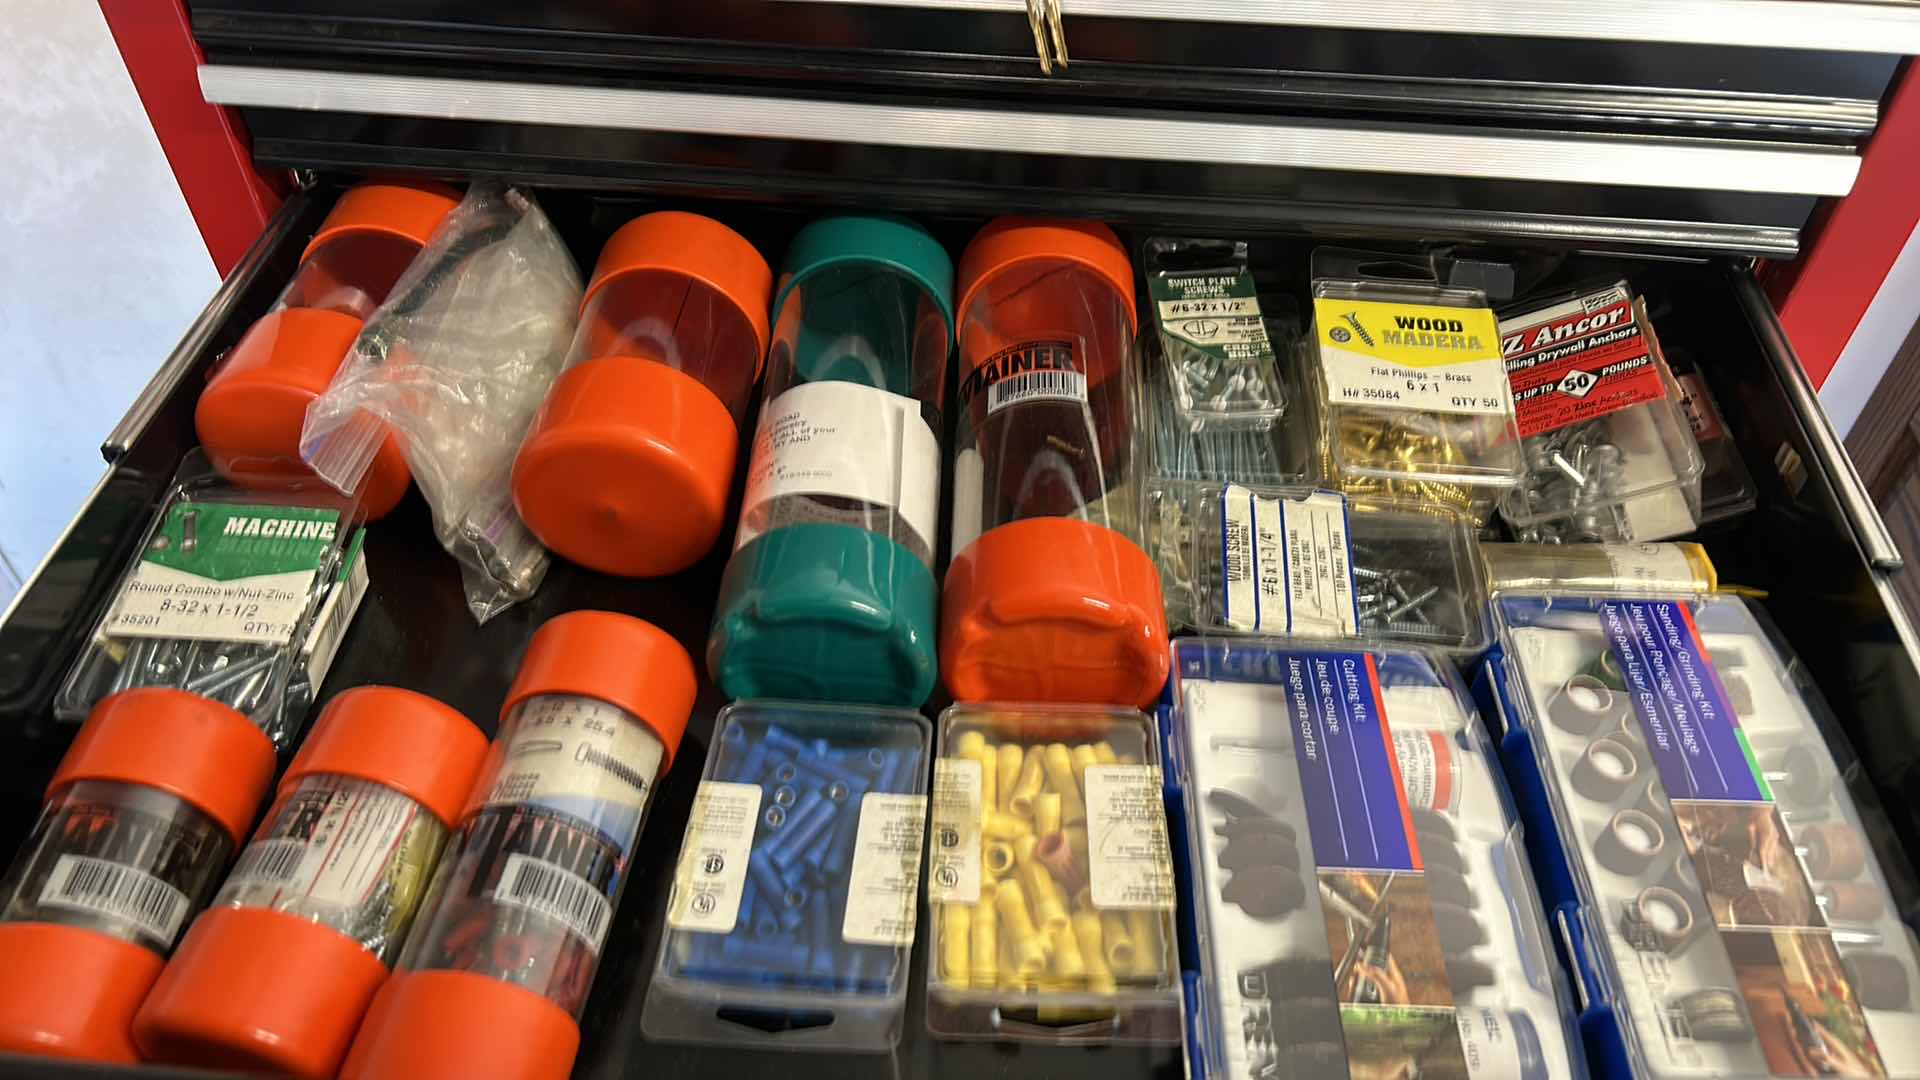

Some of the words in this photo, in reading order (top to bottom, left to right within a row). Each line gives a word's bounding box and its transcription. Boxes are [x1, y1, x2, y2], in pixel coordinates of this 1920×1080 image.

[1167, 277, 1206, 288] SWITCH
[1208, 276, 1237, 286] PLATE
[1183, 285, 1225, 295] SCREWS
[1394, 315, 1464, 333] WOOD
[1531, 305, 1626, 349] Ancor
[1381, 329, 1485, 352] MADERA
[1537, 339, 1586, 364] Drywall
[1588, 325, 1639, 349] Anchors
[1370, 366, 1390, 377] Flat
[1392, 366, 1429, 381] Phillips
[1444, 372, 1473, 383] Brass
[1406, 379, 1415, 392] 6
[1523, 386, 1539, 400] UP
[1538, 383, 1555, 396] TO
[1563, 373, 1590, 392] 50
[1602, 355, 1649, 377] POUNDS
[1451, 396, 1480, 408] QTY
[1483, 398, 1499, 408] 50
[223, 516, 337, 541] MACHINE
[128, 581, 172, 596] Round
[174, 582, 222, 598] Combo
[159, 600, 199, 615] 8-32
[216, 601, 260, 620] 1-1/2
[1604, 603, 1625, 637] Juego
[1615, 635, 1636, 662] para
[1630, 603, 1643, 622] Jeu
[1637, 622, 1657, 650] pour
[1288, 657, 1304, 693] Juego
[1315, 658, 1329, 681] Jeu
[1320, 680, 1334, 696] de
[1342, 658, 1361, 703] Cutting
[1353, 702, 1367, 723] Kit
[1296, 692, 1311, 721] para
[1323, 695, 1340, 735] coupe
[1698, 700, 1715, 721] Kit
[1301, 719, 1318, 761] cortar
